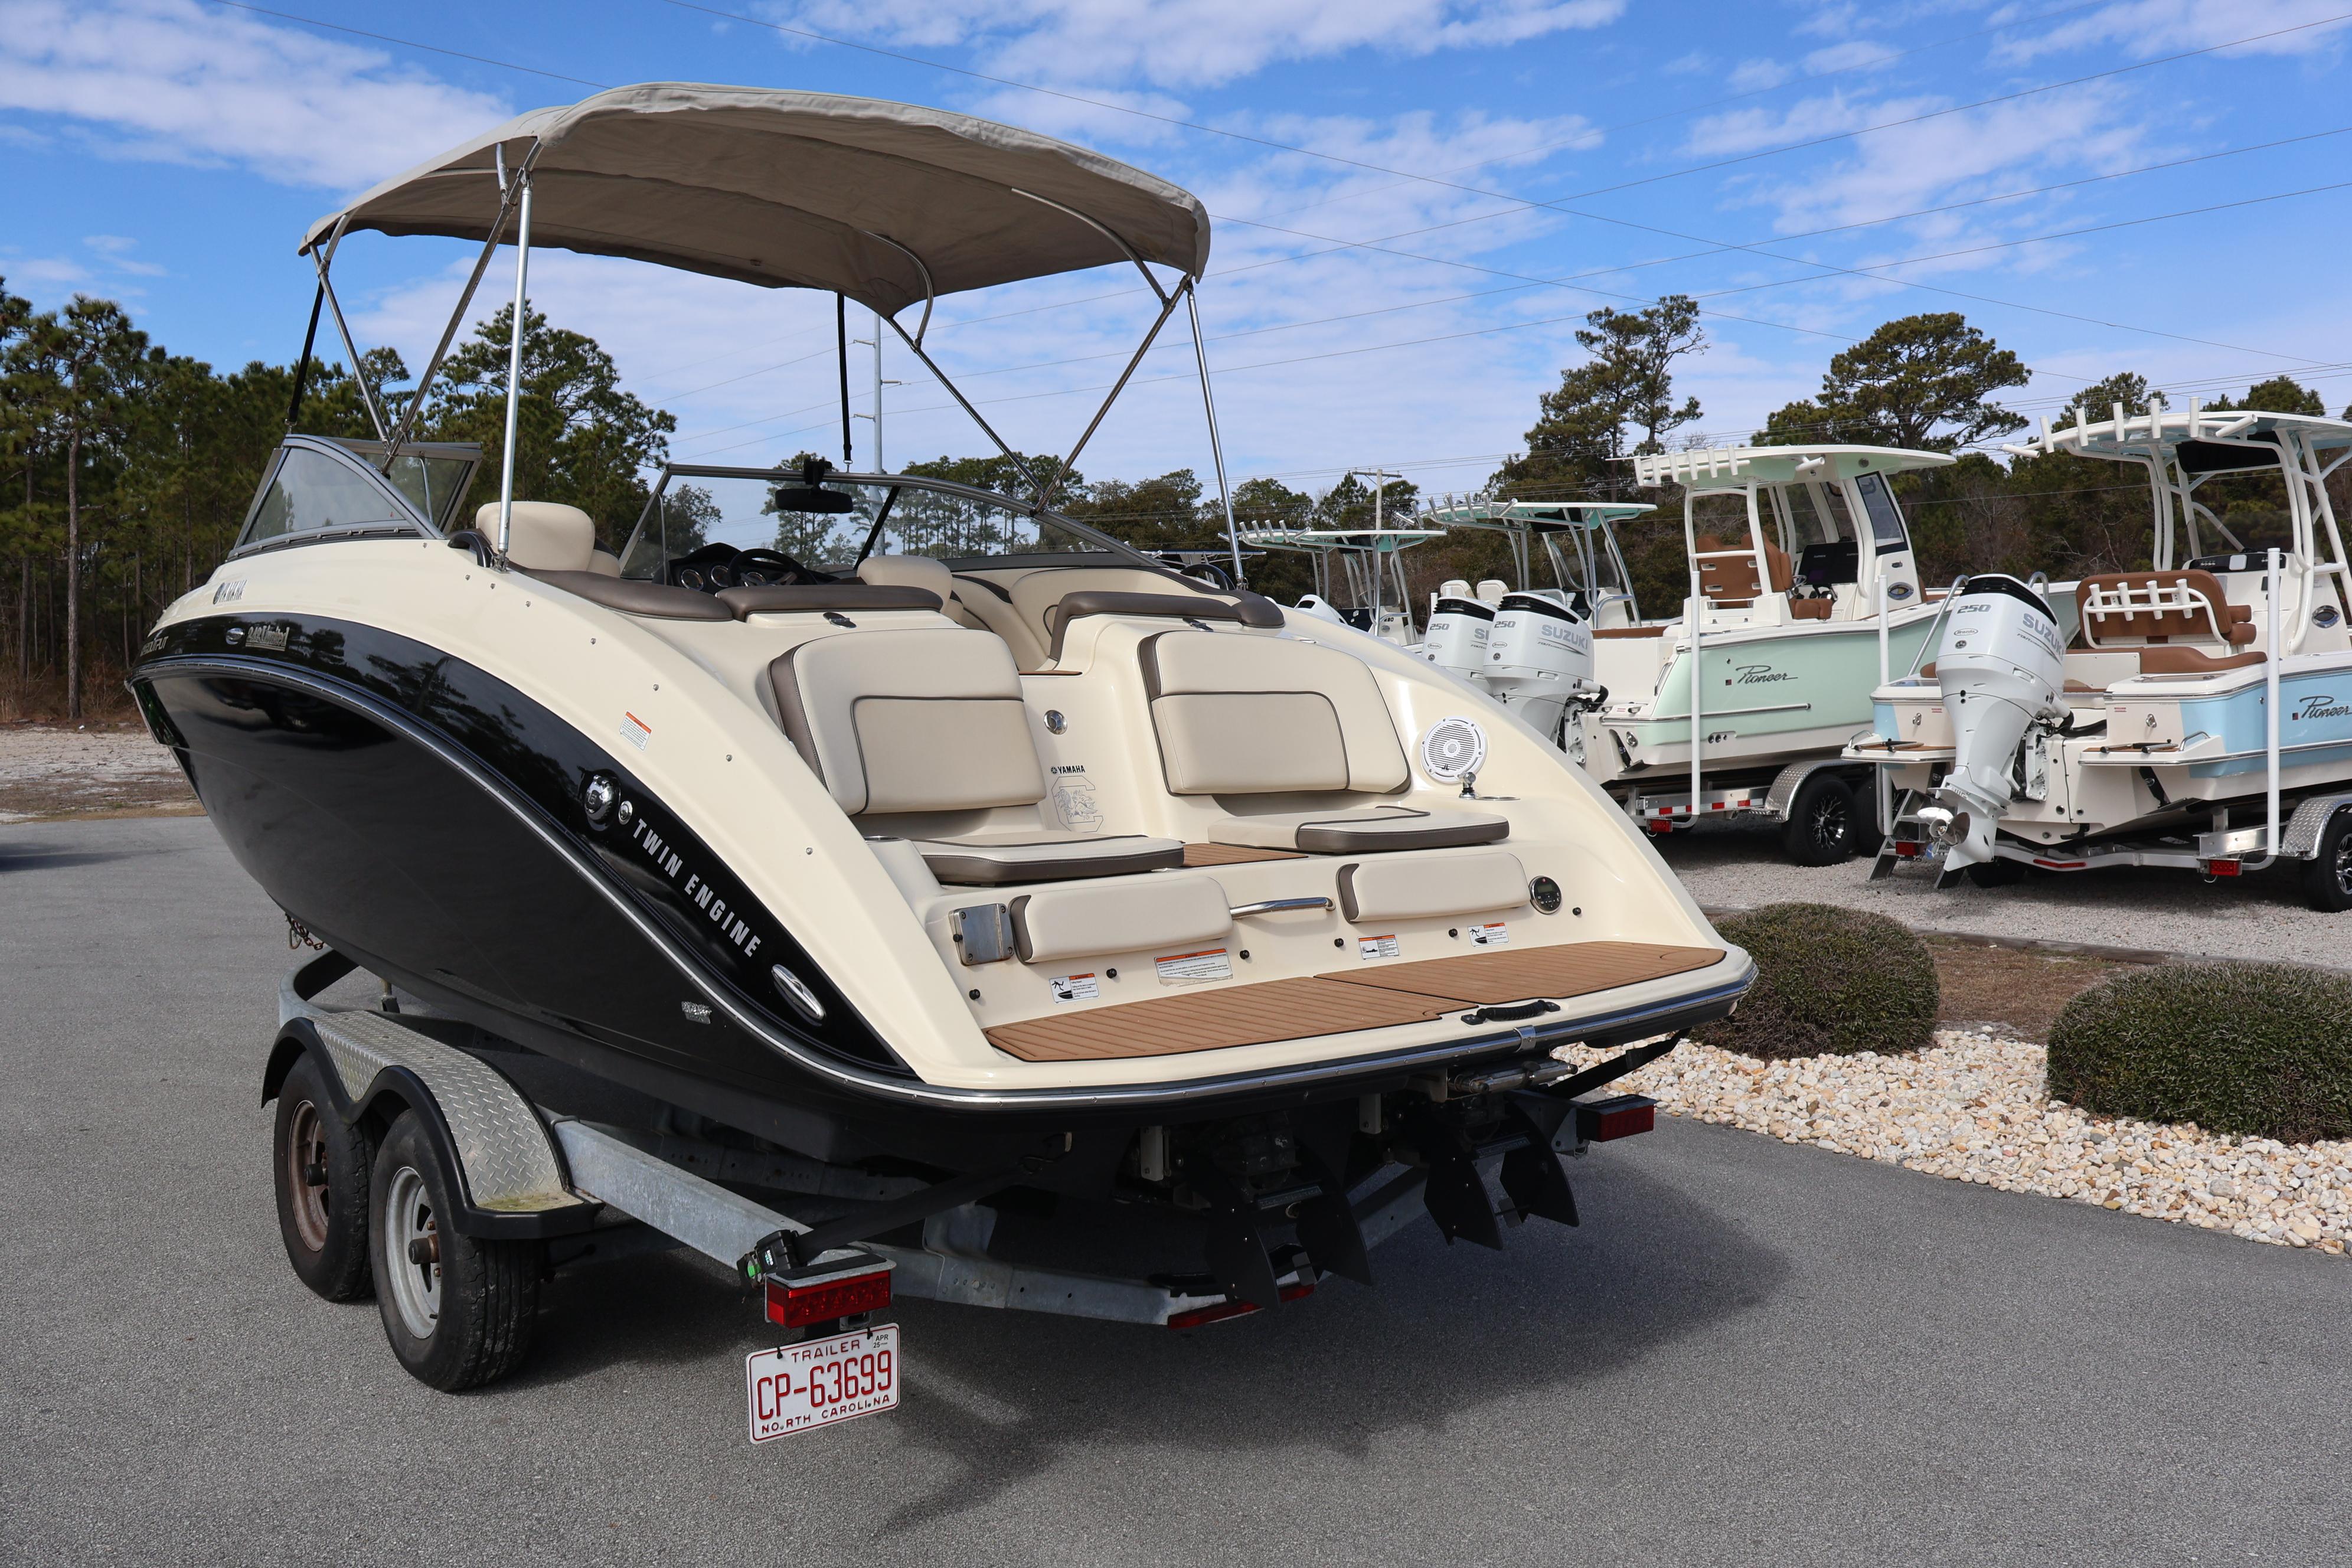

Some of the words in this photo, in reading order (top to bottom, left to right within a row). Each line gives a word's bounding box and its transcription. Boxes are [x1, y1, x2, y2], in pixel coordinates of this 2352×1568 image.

[1957, 604, 1992, 614] 250
[1541, 624, 1588, 649] SUZUKI
[2023, 613, 2064, 661] SUZUKI
[1736, 665, 1798, 684] Pioneer
[2299, 695, 2352, 718] Pioneer
[1057, 765, 1085, 774] YAMAHA
[632, 818, 683, 878] TWIN
[684, 874, 762, 958] ENGINE
[791, 1340, 860, 1363] TRAILER
[757, 1350, 892, 1420] CP-63699
[762, 1415, 811, 1434] NORTH
[821, 1394, 890, 1419] CAROLINA
